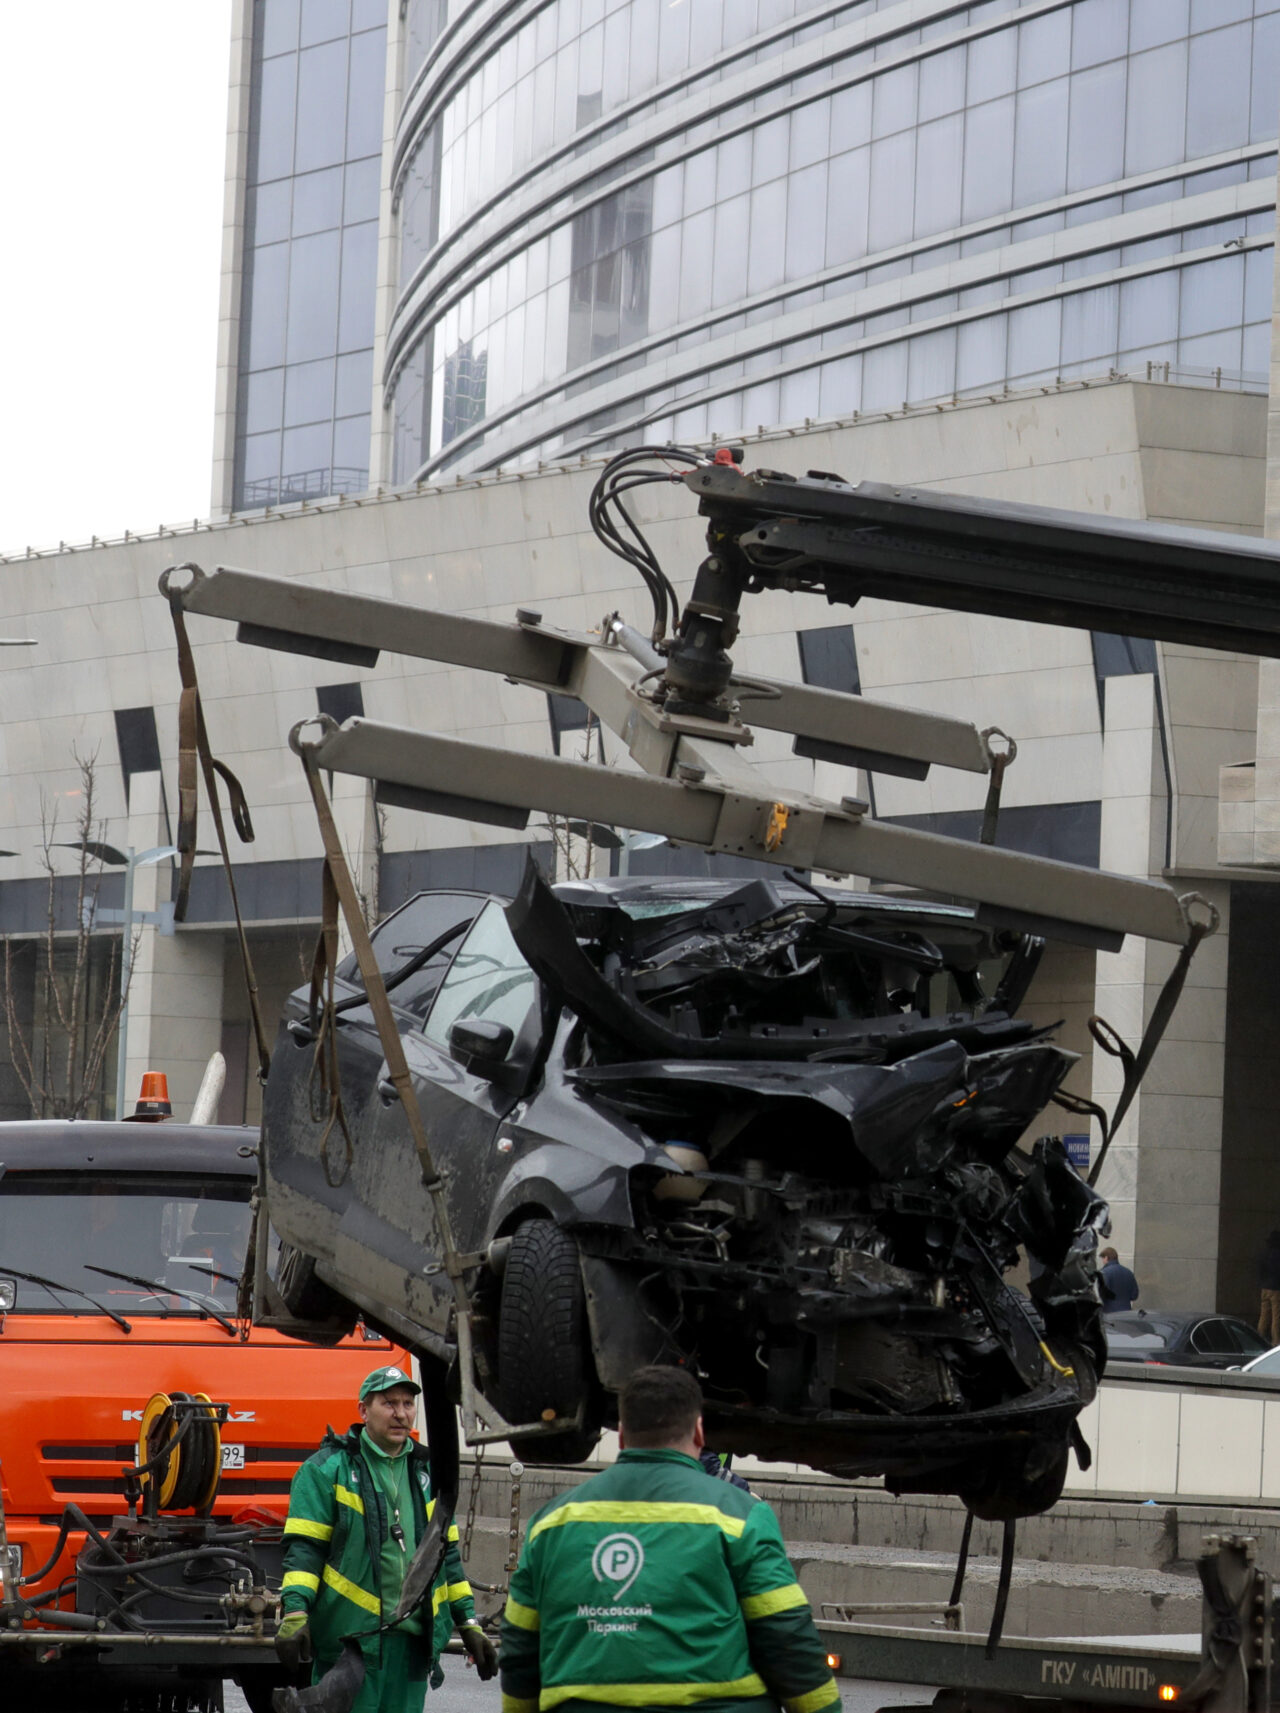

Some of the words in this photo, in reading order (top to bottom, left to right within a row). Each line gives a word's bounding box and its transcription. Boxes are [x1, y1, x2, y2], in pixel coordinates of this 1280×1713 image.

[577, 1603, 653, 1617] Московский
[586, 1619, 639, 1637] Паркинг
[1041, 1660, 1077, 1685] ГКУ
[1083, 1663, 1156, 1691] «АМПП»
